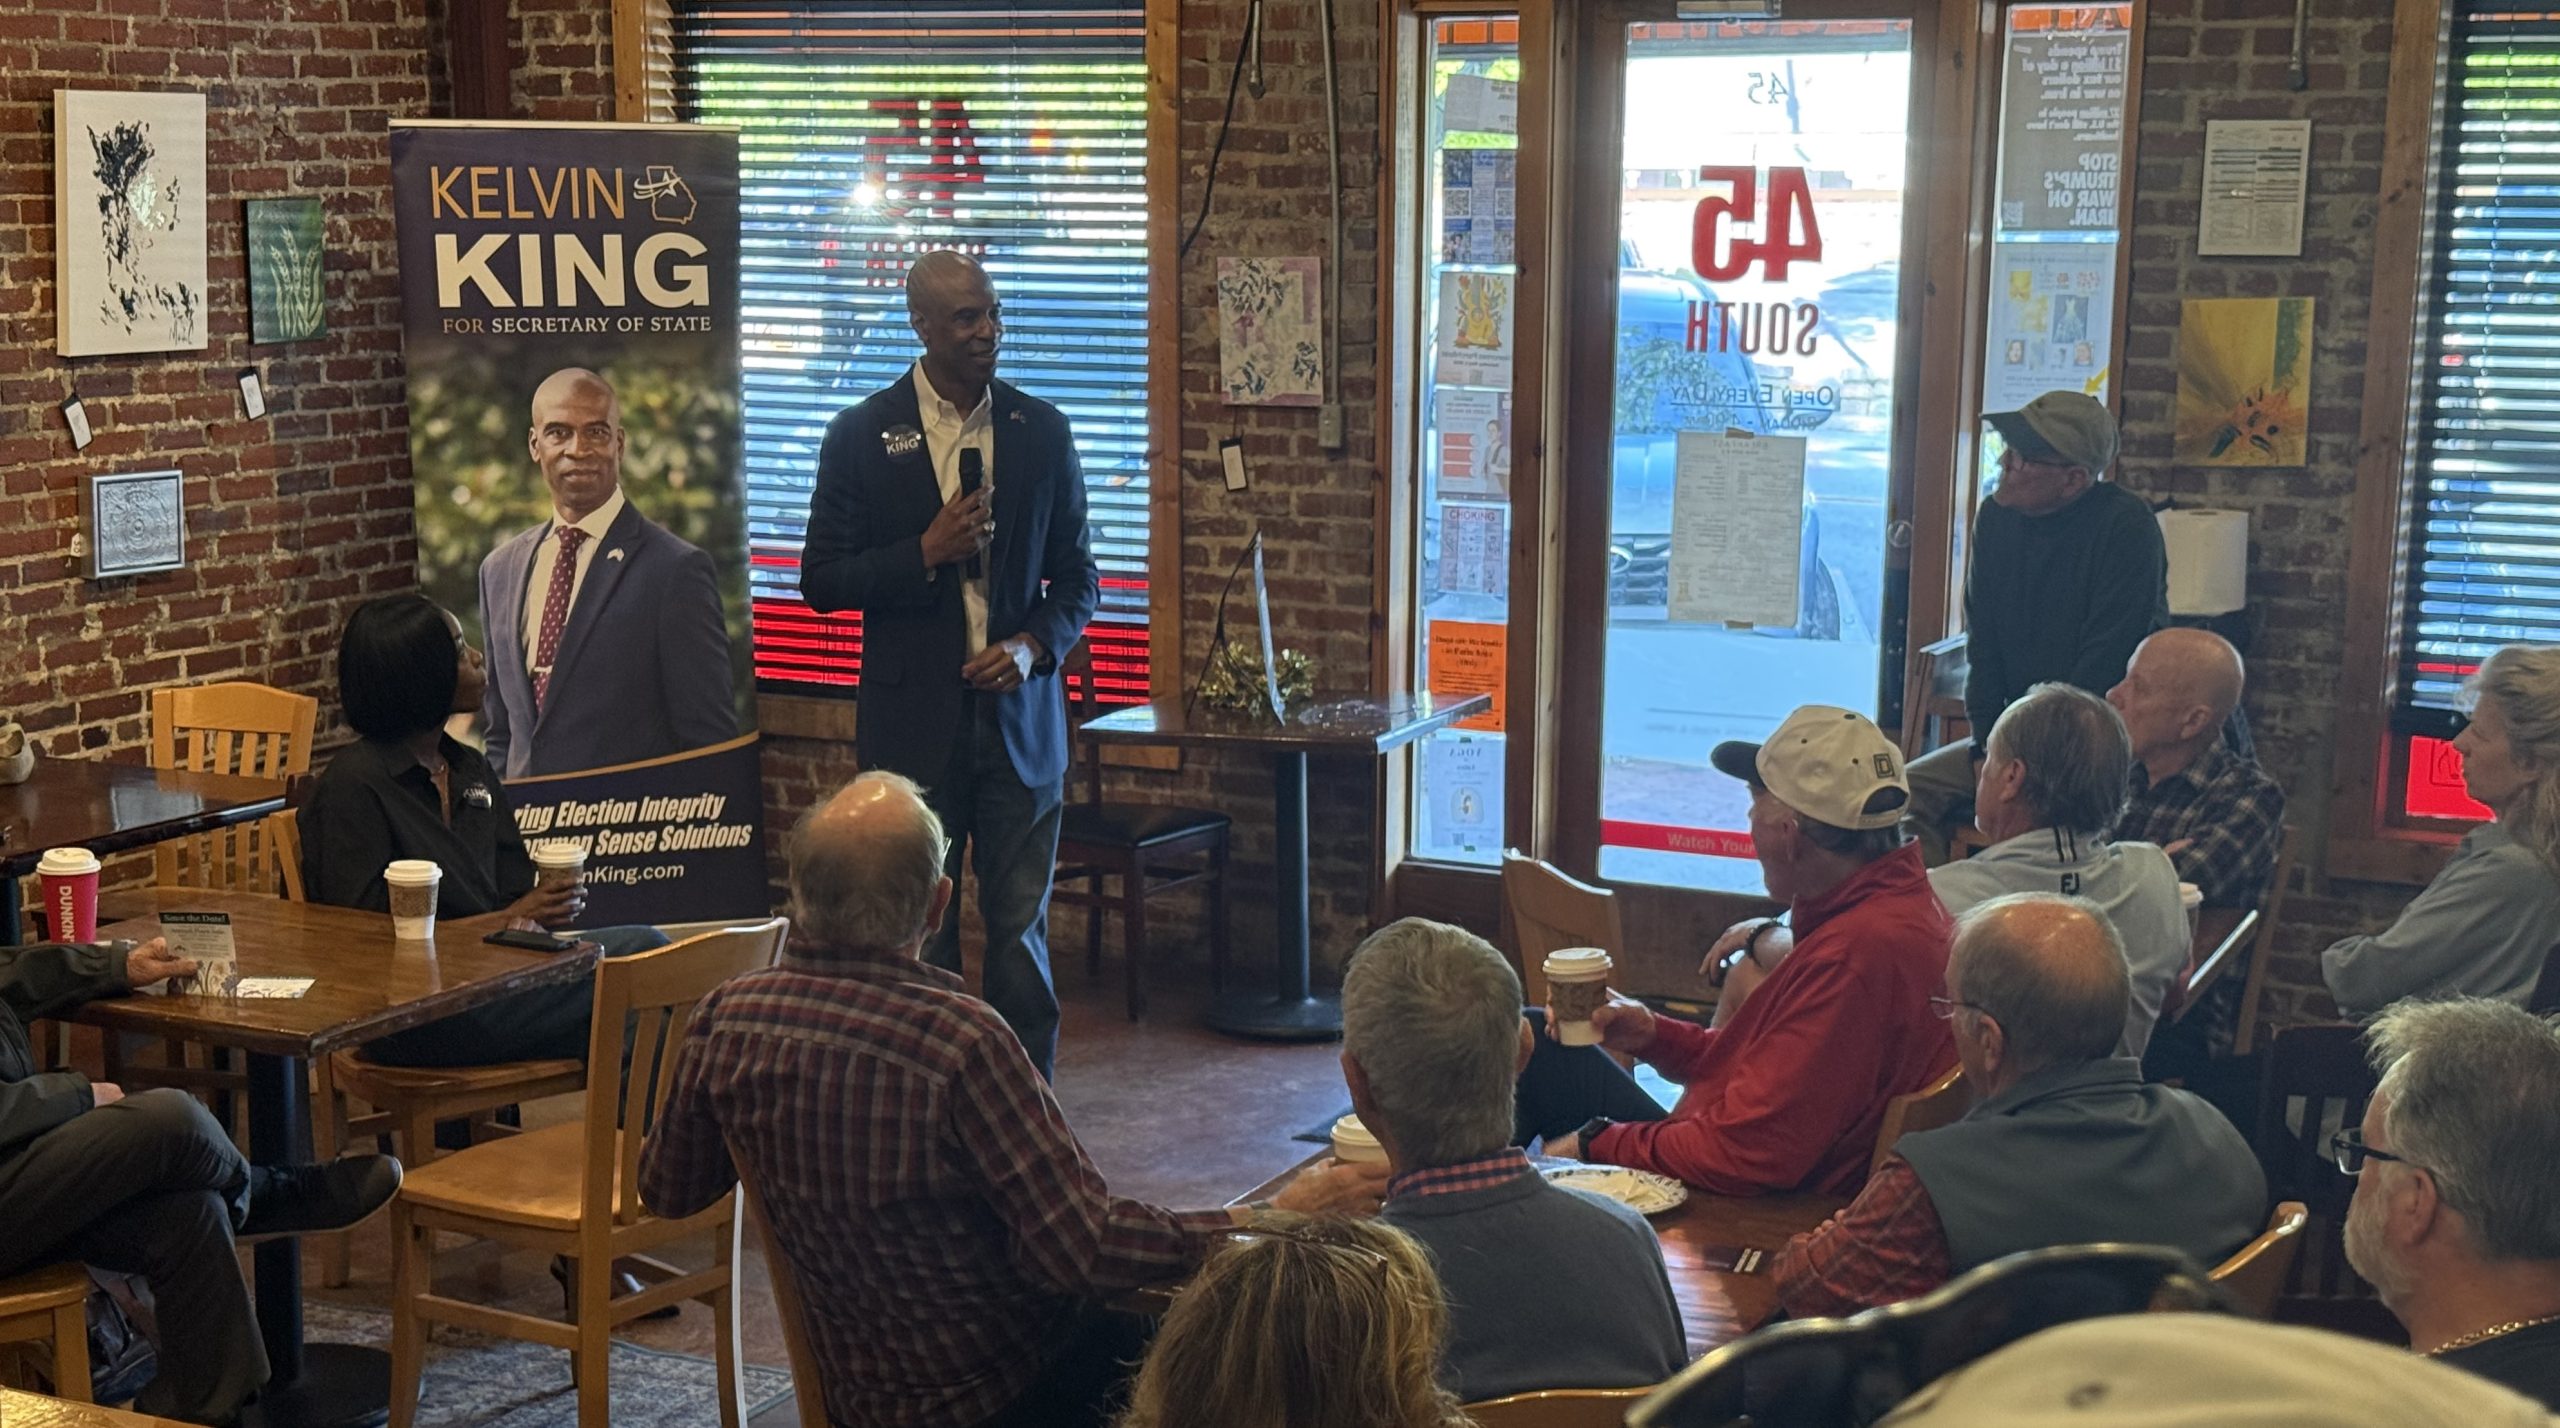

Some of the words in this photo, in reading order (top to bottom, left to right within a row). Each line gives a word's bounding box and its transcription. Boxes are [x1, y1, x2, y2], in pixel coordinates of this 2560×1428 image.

[430, 166, 625, 219] KELVIN
[435, 232, 710, 308] KING
[443, 318, 484, 334] FOR
[492, 317, 610, 333] SECRETARY
[617, 317, 644, 333] OF
[650, 316, 711, 332] STATE
[886, 438, 919, 455] KING
[1449, 509, 1495, 522] CHOKING
[514, 803, 555, 834] ring
[555, 798, 638, 829] Election
[638, 791, 726, 824] Integrity
[595, 828, 657, 857] Sense
[658, 822, 753, 852] Solutions
[1666, 832, 1716, 849] Watch
